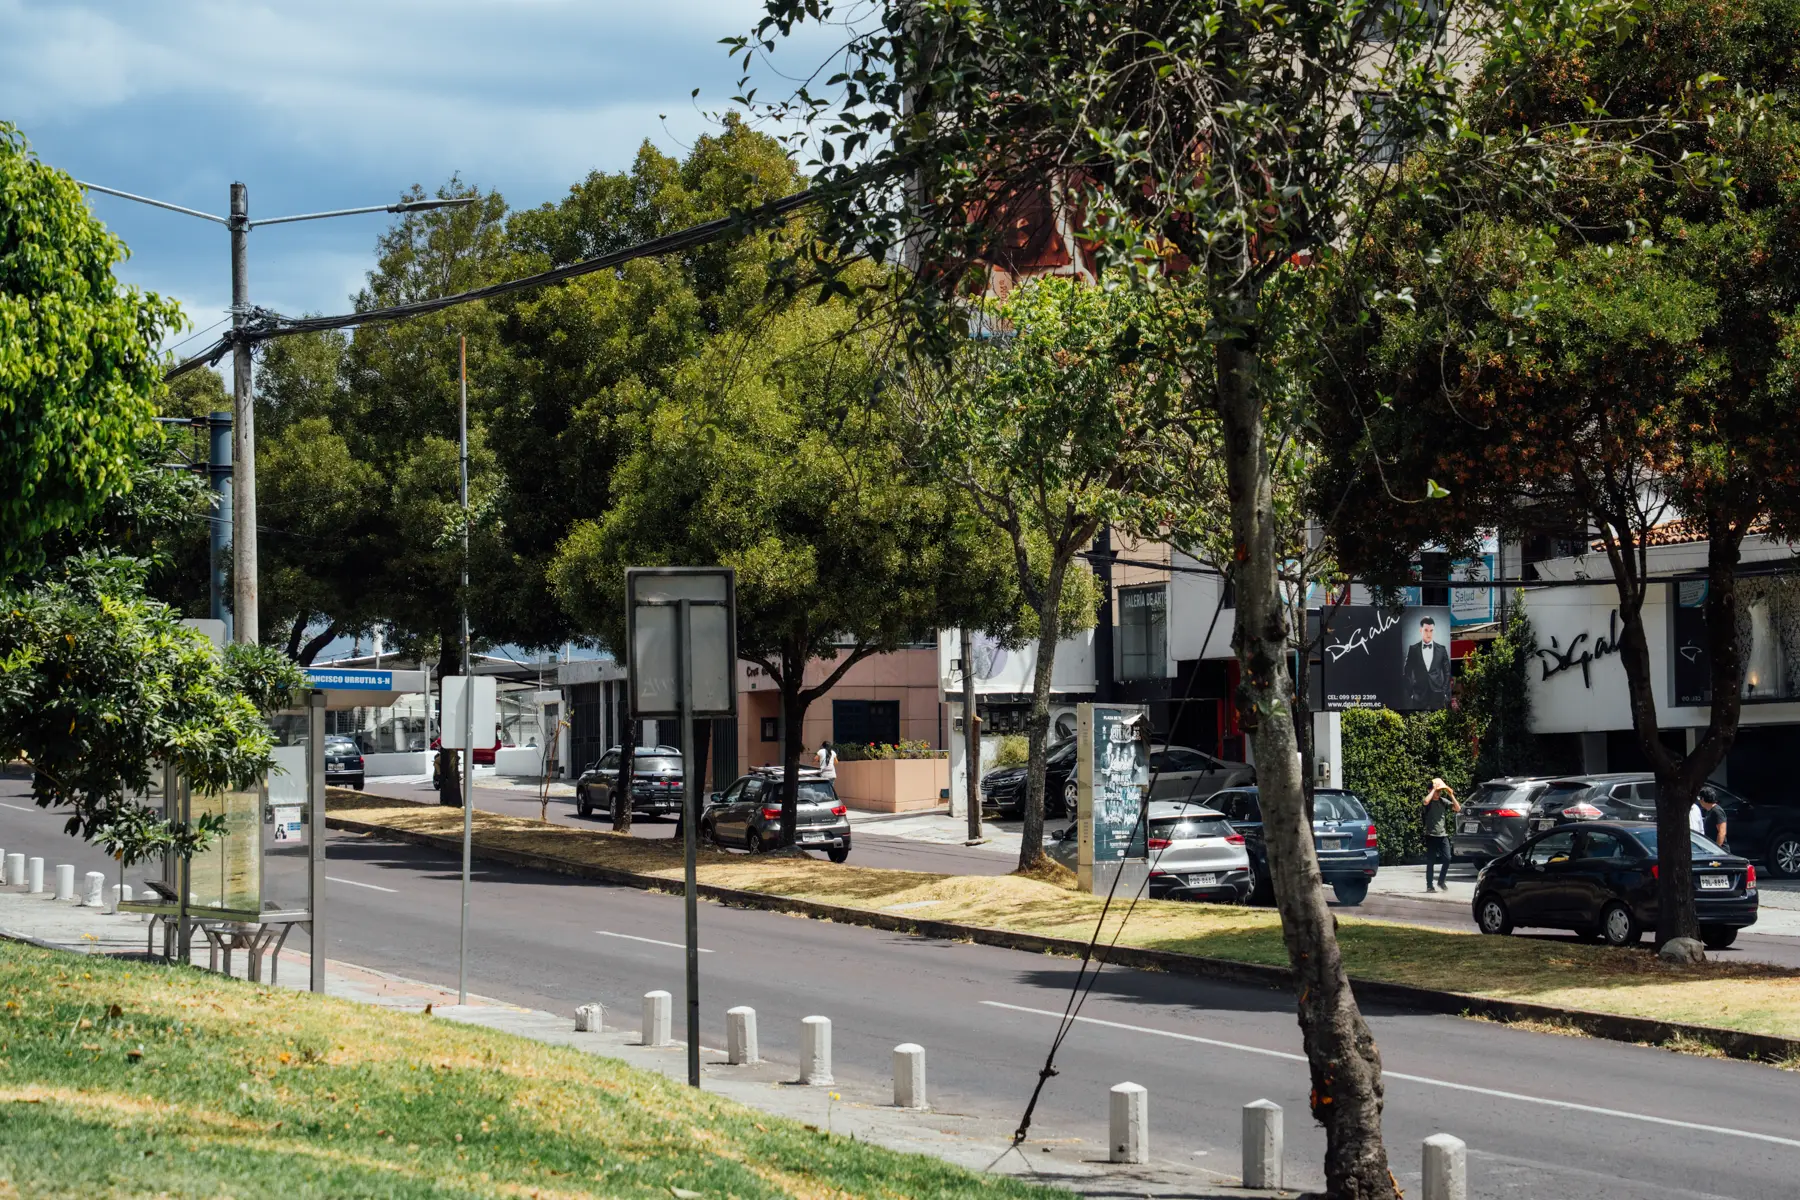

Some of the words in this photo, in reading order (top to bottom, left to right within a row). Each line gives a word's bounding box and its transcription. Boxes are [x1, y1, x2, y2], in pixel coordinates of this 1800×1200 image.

[1124, 590, 1145, 608] GALERÍA
[1146, 592, 1154, 606] DE
[1455, 590, 1474, 602] Salud
[1535, 608, 1622, 689] D'Gal
[304, 675, 343, 684] RANCISCO
[344, 675, 376, 685] URRUTIA
[377, 676, 390, 685] S-N
